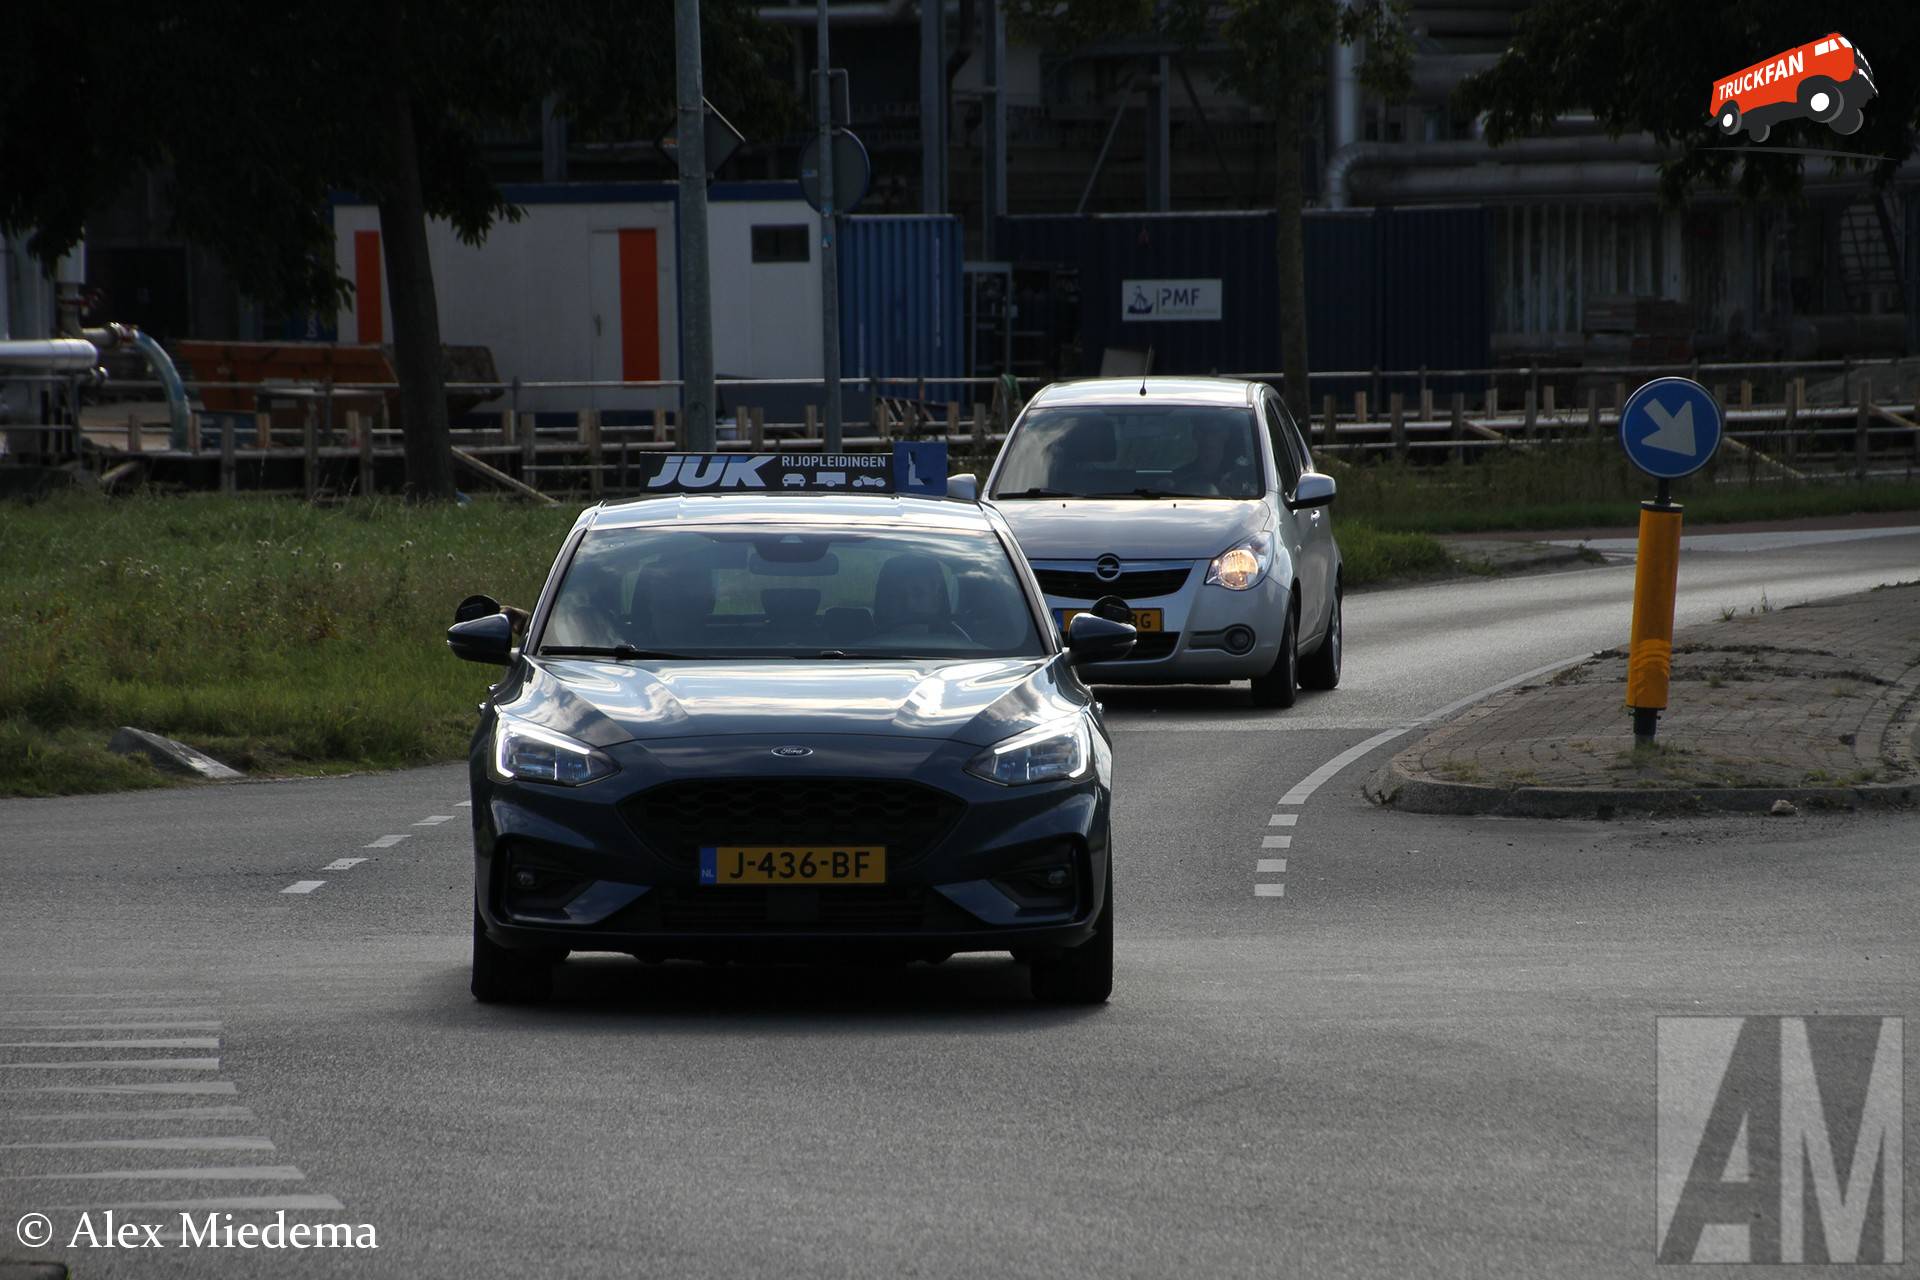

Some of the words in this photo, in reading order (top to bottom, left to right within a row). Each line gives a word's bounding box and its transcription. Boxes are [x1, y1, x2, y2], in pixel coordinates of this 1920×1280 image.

[1161, 288, 1200, 306] PMF
[647, 455, 777, 488] JUK
[782, 455, 886, 468] RIJOPLEIDINGEN
[701, 868, 715, 878] NL
[729, 851, 870, 879] J-436-BF
